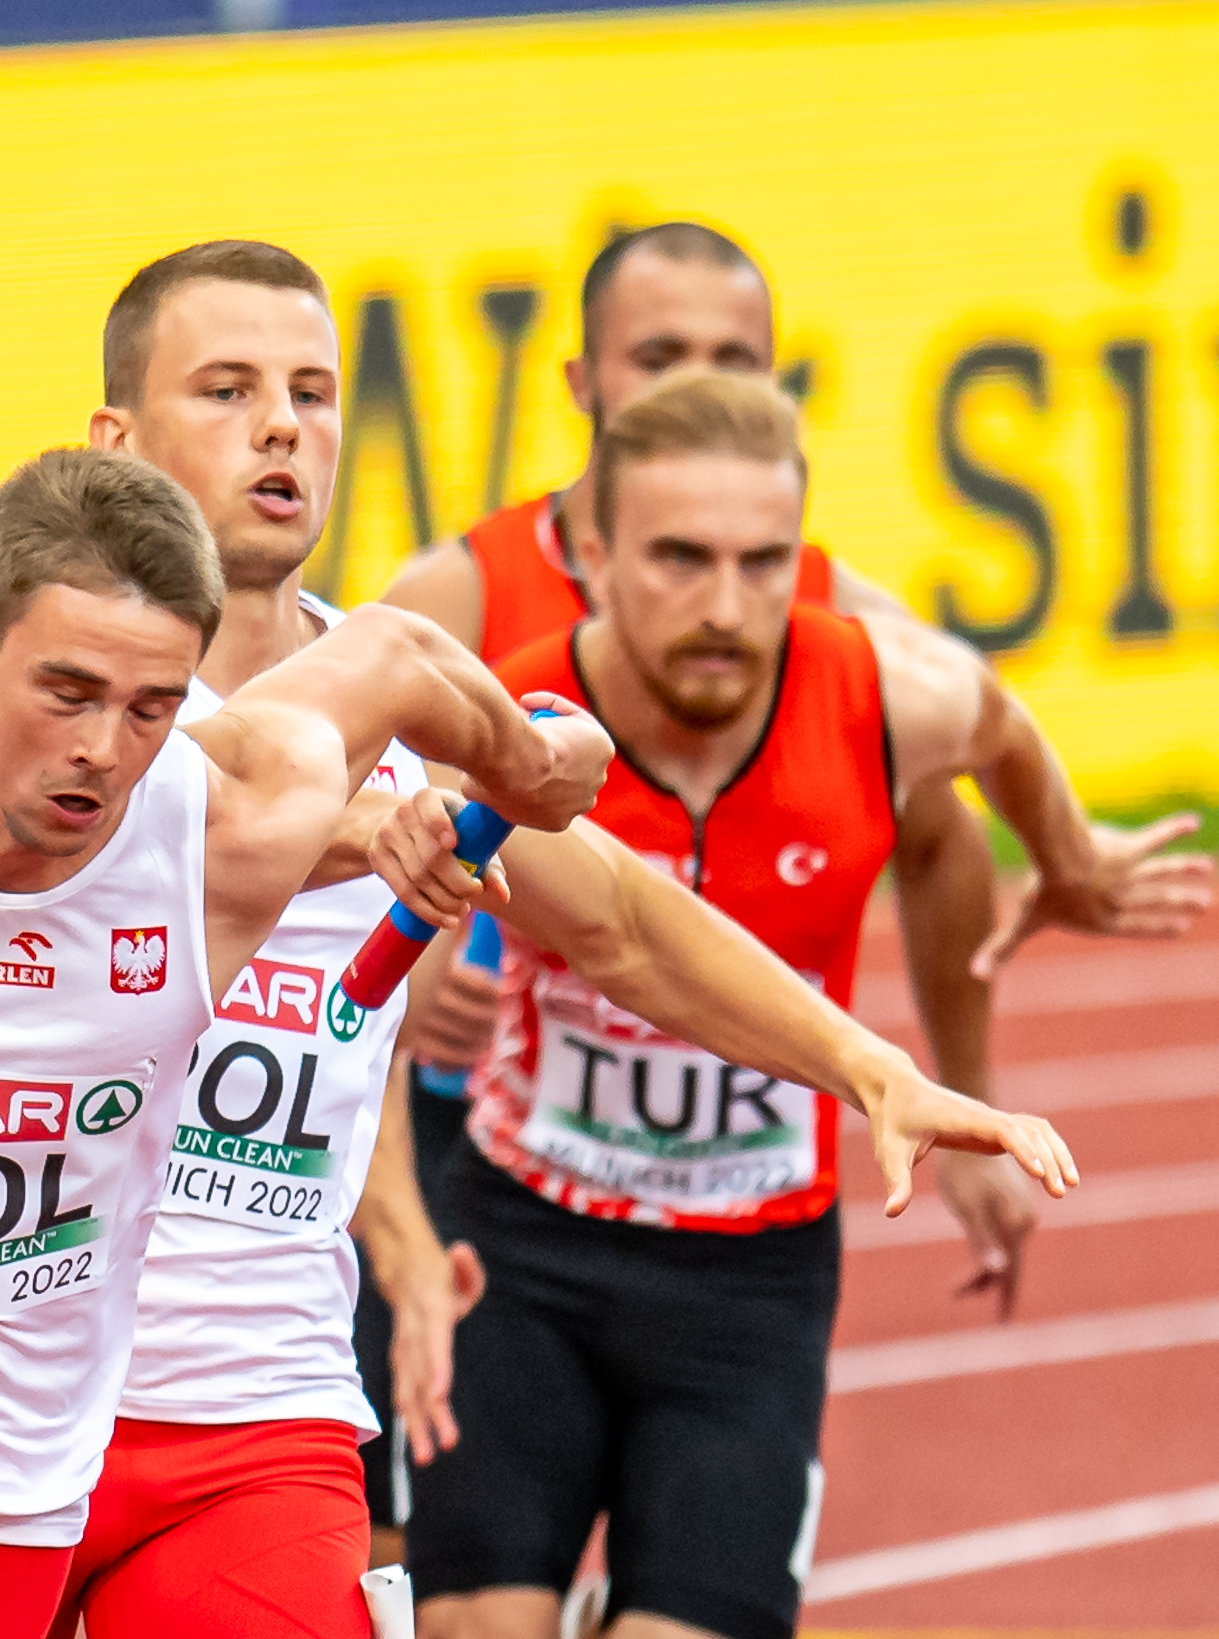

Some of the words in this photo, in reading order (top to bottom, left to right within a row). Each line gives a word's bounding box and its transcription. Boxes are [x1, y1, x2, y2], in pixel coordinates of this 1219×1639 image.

[934, 190, 1174, 650] si
[221, 964, 313, 1024] AR
[188, 1041, 330, 1150] OL
[562, 1032, 783, 1138] TUR
[174, 1128, 211, 1154] UN
[164, 1161, 236, 1207] ICH
[246, 1181, 322, 1221] 2022
[10, 1251, 93, 1302] 2022
